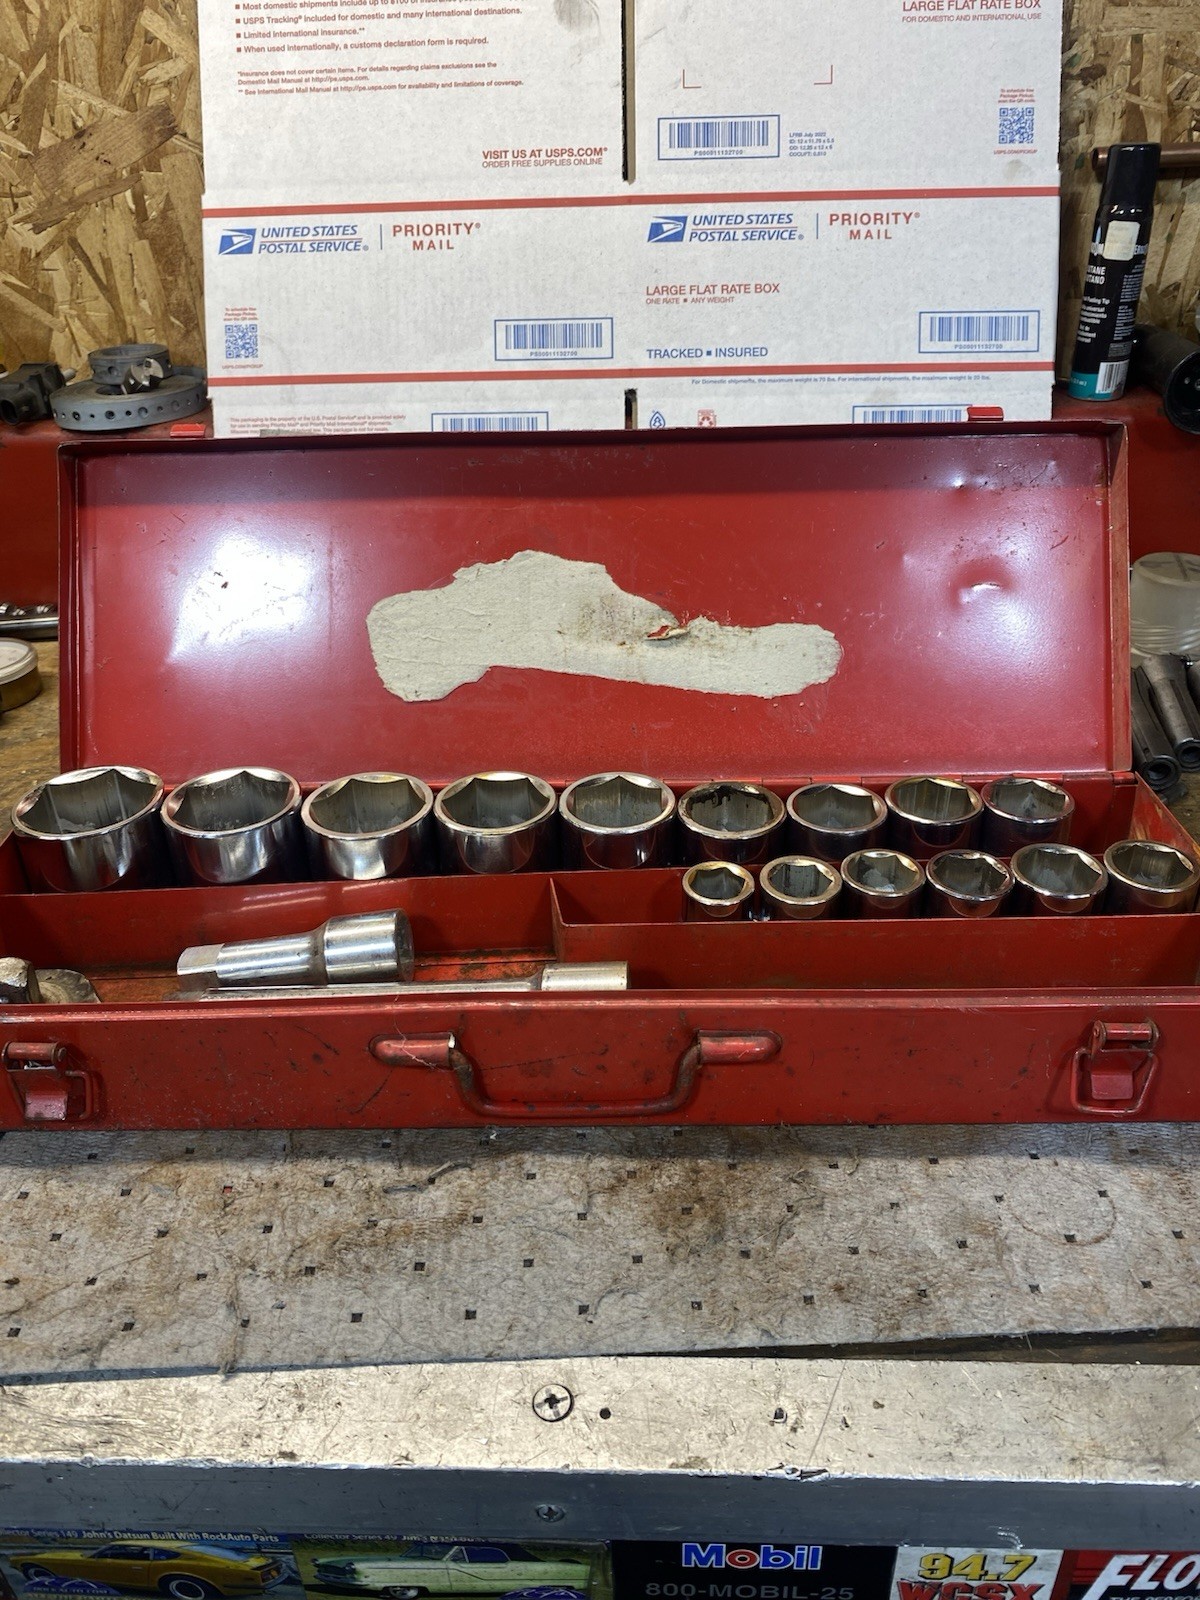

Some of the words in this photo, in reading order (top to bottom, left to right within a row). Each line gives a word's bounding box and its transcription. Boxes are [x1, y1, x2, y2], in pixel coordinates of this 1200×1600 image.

[243, 2, 261, 10] Most
[264, 1, 298, 10] domestic
[300, 0, 338, 9] shipments
[902, 0, 944, 12] LARGE
[948, 0, 976, 10] FLAT
[980, 0, 1012, 10] RATE
[1015, 0, 1042, 9] BOX
[243, 16, 264, 24] USPS
[350, 12, 385, 20] domestic
[403, 12, 424, 20] many
[474, 7, 522, 16] destinations.
[902, 14, 916, 22] FOR
[918, 14, 954, 22] DOMESTIC
[956, 14, 970, 22] AND
[972, 13, 1026, 22] INTERNATIONAL
[244, 31, 270, 39] Limited
[384, 40, 426, 48] declaration
[455, 37, 489, 45] required.
[482, 150, 509, 160] VISIT
[512, 150, 527, 159] US
[529, 149, 543, 158] AT
[482, 160, 510, 168] ORDER
[512, 160, 532, 168] FREE
[534, 158, 572, 167] SUPPLIES
[574, 158, 602, 166] ONLINE
[692, 214, 743, 226] UNITED
[746, 213, 794, 224] STATES
[260, 226, 312, 238] UNITED
[312, 224, 358, 236] STATES
[689, 230, 740, 242] POSTAL
[849, 228, 892, 240] MAIL
[258, 242, 308, 254] POSTAL
[412, 239, 455, 250] MAIL
[646, 285, 686, 296] LARGE
[689, 284, 718, 296] FLAT
[720, 284, 751, 294] RATE
[754, 283, 780, 294] BOX
[708, 296, 734, 304] WEIGHT
[646, 348, 704, 359] TRACKED
[715, 347, 768, 358] INSURED
[82, 1531, 114, 1539] John's
[114, 1531, 150, 1540] Datsun
[152, 1531, 176, 1540] Built
[176, 1532, 201, 1540] With
[202, 1532, 252, 1542] RockAuto
[253, 1534, 280, 1542] Parts
[682, 1543, 822, 1570] Mobil
[918, 1553, 1038, 1582] 94.7
[645, 1582, 854, 1600] 800-MOBIL-25
